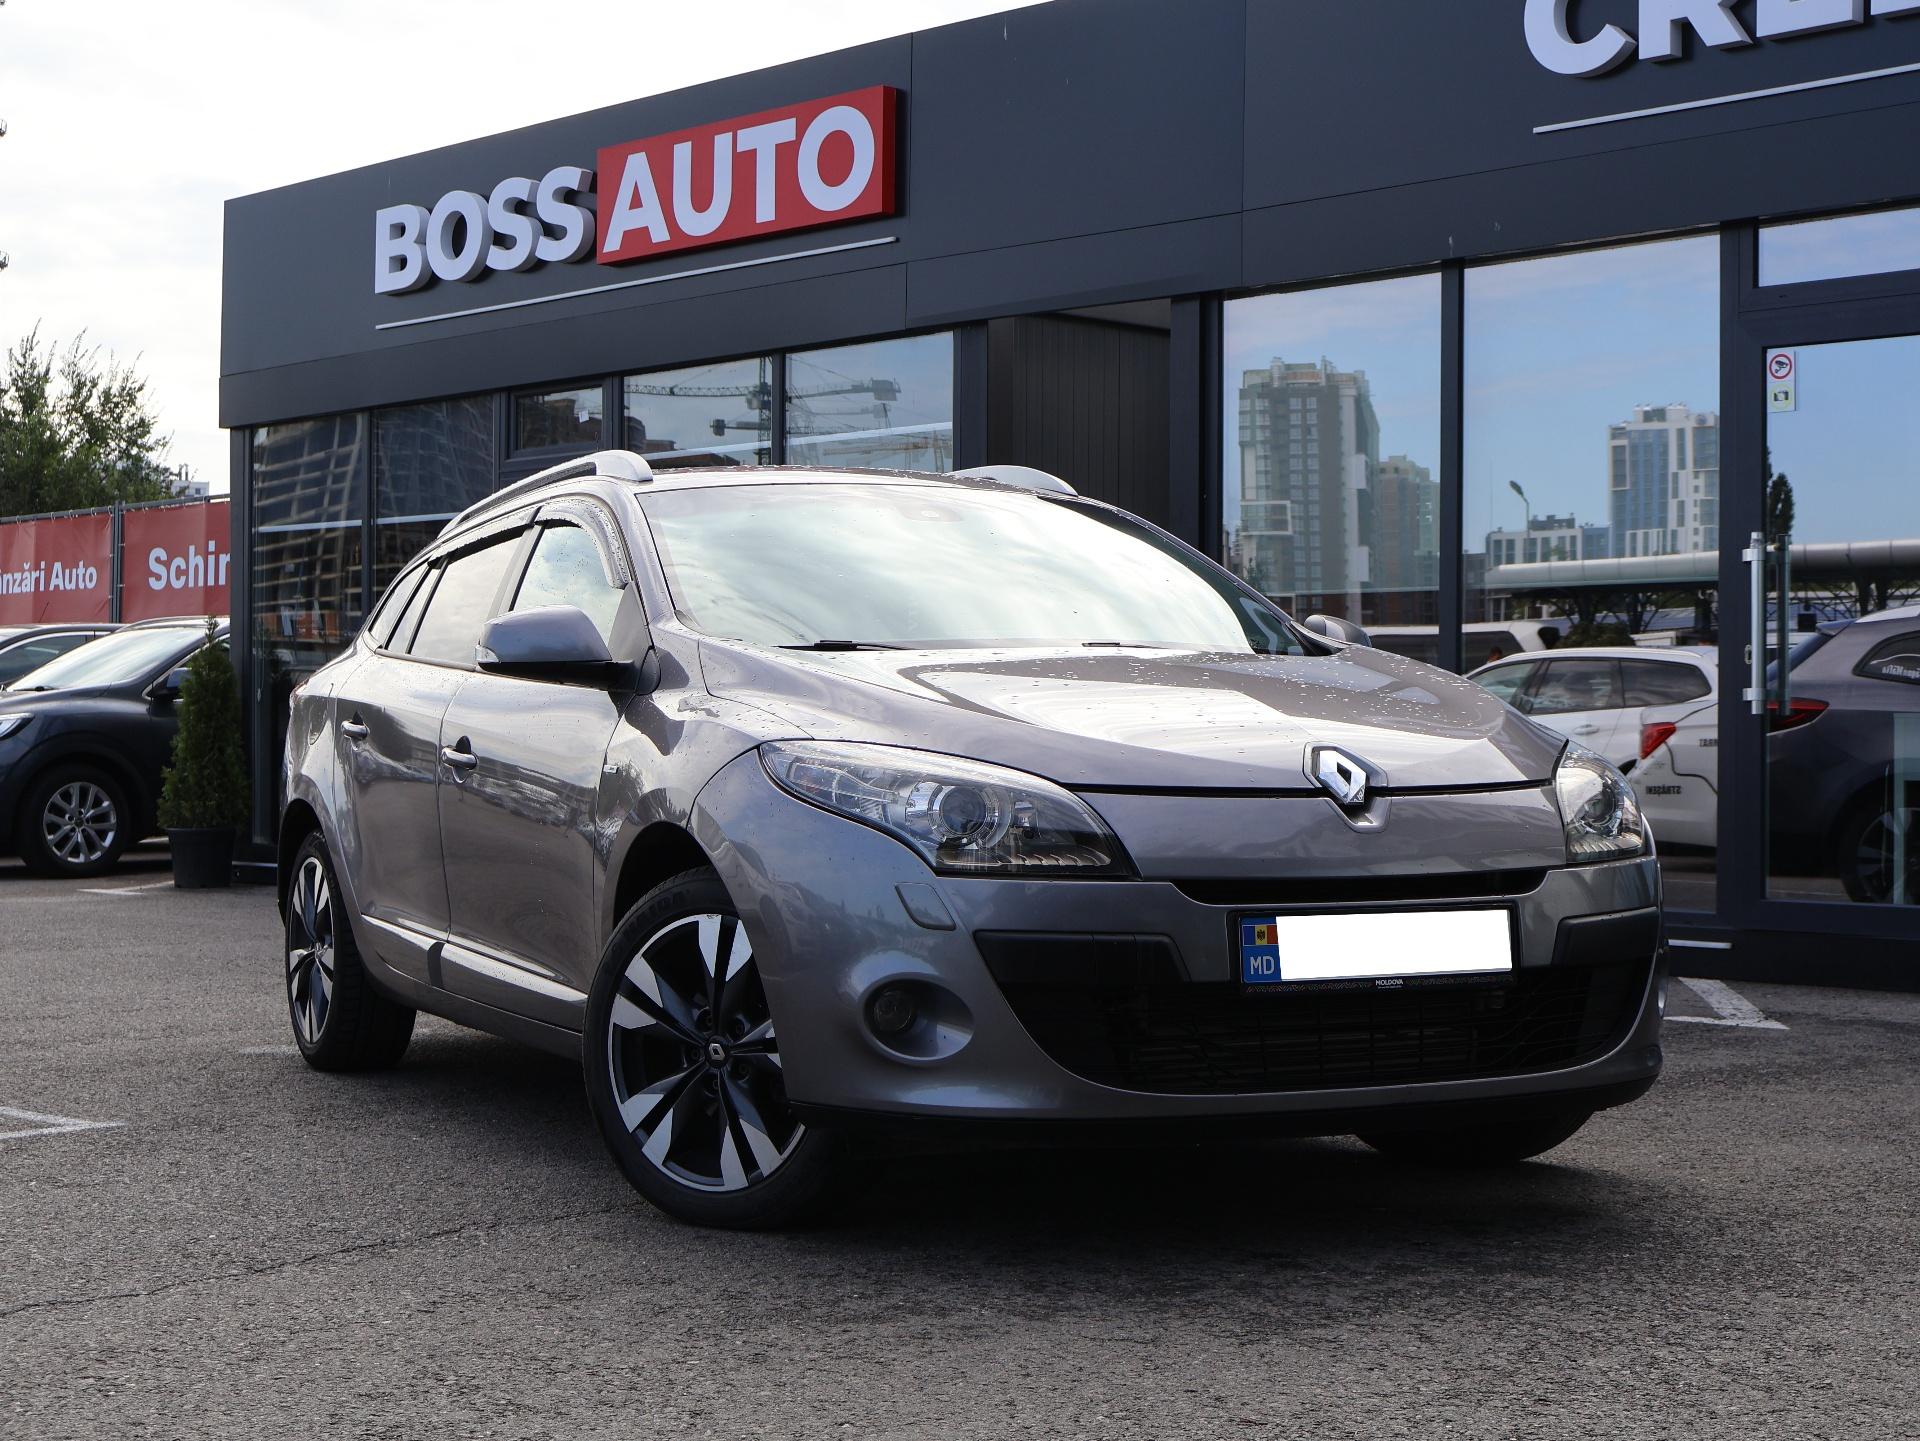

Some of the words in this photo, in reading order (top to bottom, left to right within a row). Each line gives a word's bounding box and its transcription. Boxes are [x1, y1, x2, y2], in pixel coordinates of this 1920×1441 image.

[374, 165, 597, 295] BOSS
[602, 103, 876, 254] AUTO
[0, 560, 46, 595] nzări
[49, 559, 98, 592] Auto
[1249, 955, 1275, 975] MD
[1375, 978, 1404, 986] MOLDOVA
